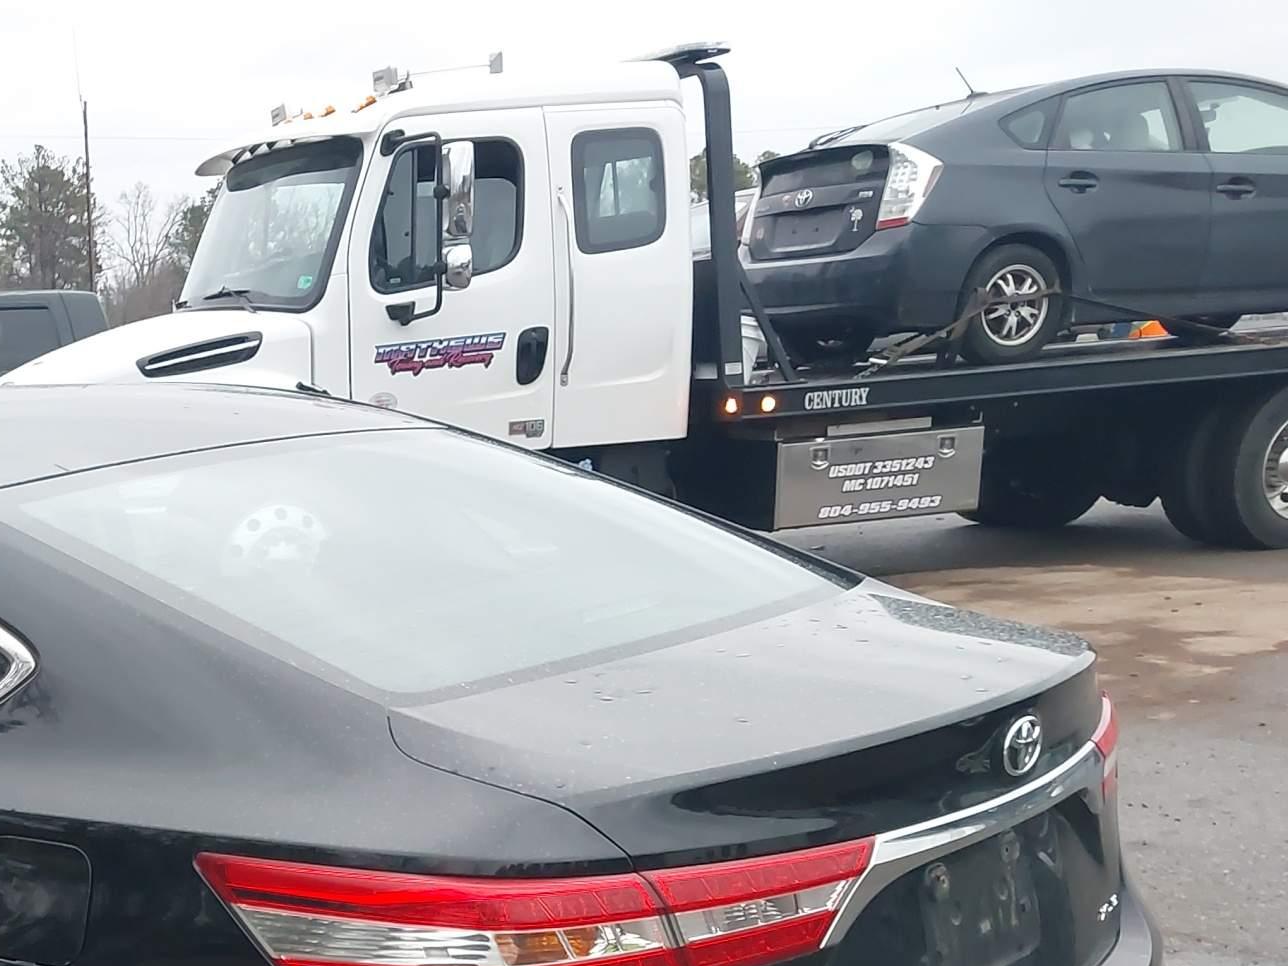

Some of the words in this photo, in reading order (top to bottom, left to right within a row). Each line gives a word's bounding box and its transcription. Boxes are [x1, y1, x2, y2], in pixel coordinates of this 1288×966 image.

[804, 387, 870, 410] CENTURY
[828, 462, 872, 478] USDOT
[872, 456, 935, 474] 3351243
[842, 479, 864, 492] MC
[865, 473, 919, 490] 1071451
[818, 496, 942, 519] 804-955-9493
